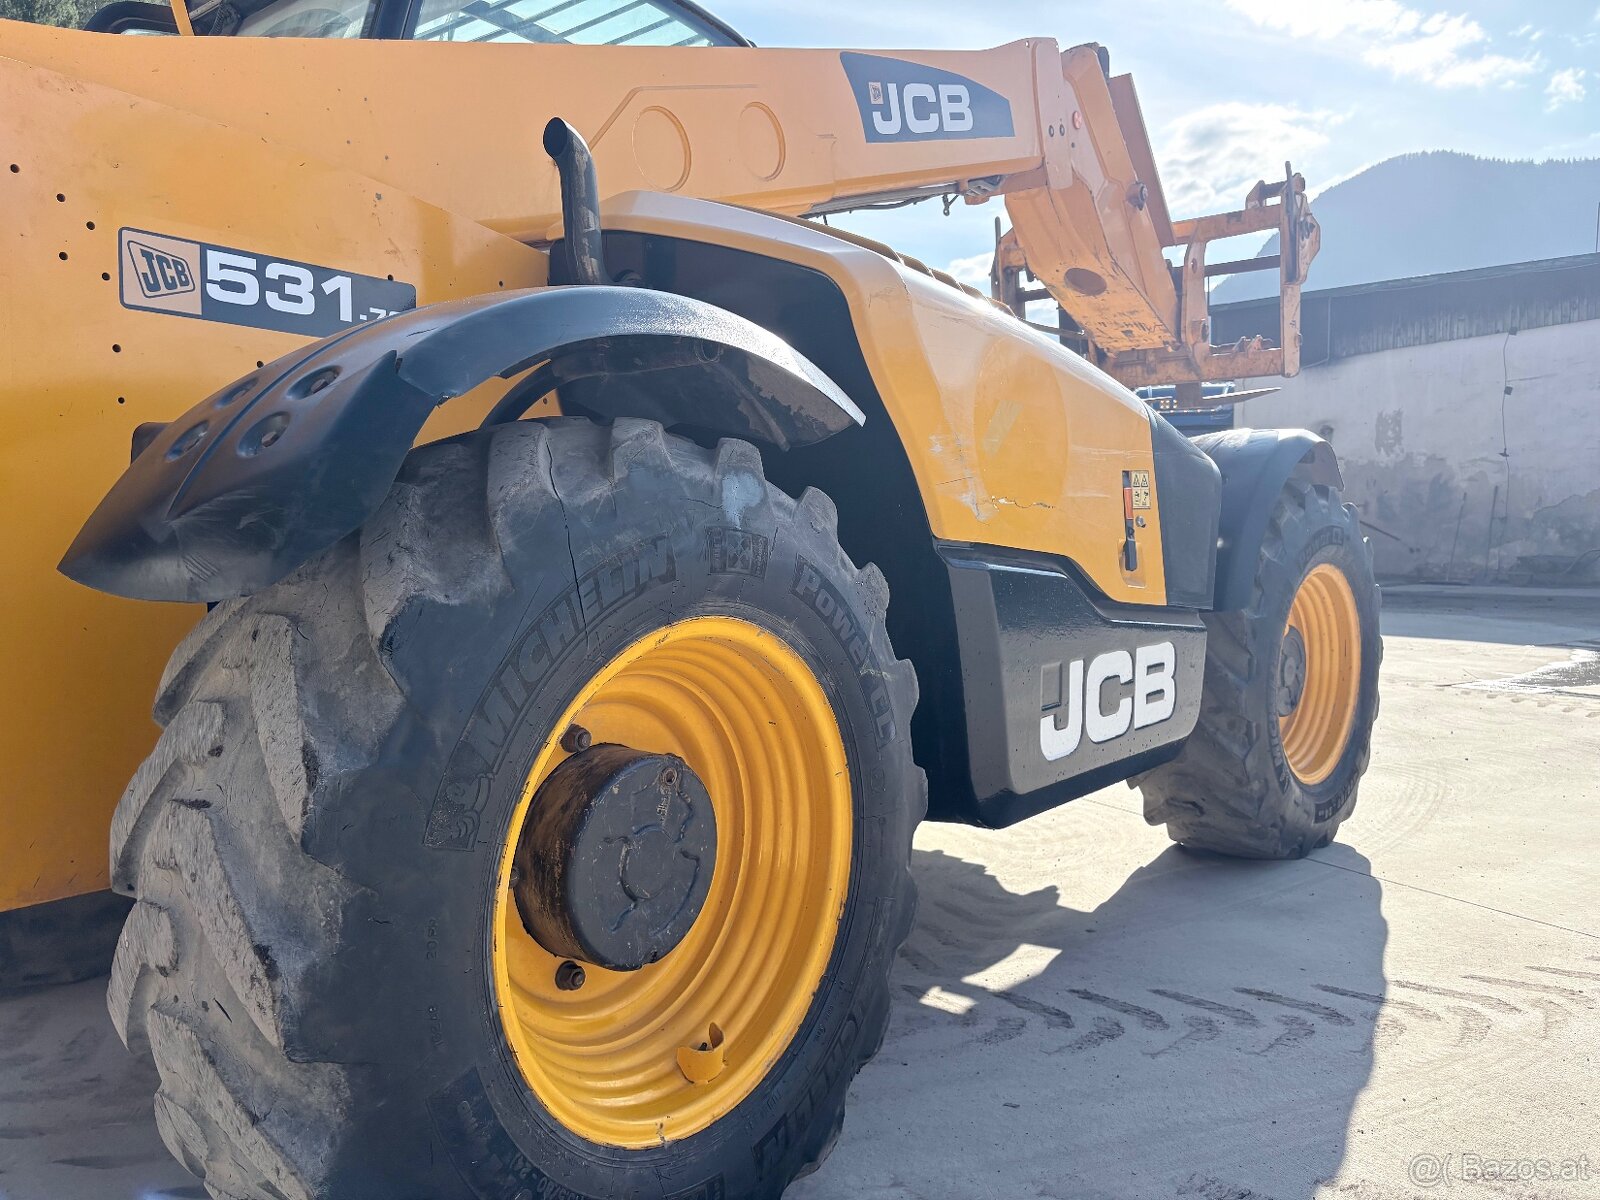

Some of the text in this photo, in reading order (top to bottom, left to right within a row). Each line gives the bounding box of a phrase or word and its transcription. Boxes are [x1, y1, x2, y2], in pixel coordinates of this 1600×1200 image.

[872, 82, 974, 135] JCB
[140, 248, 191, 293] JCB
[466, 535, 676, 772] MICHELIN
[1040, 641, 1176, 761] JCB
